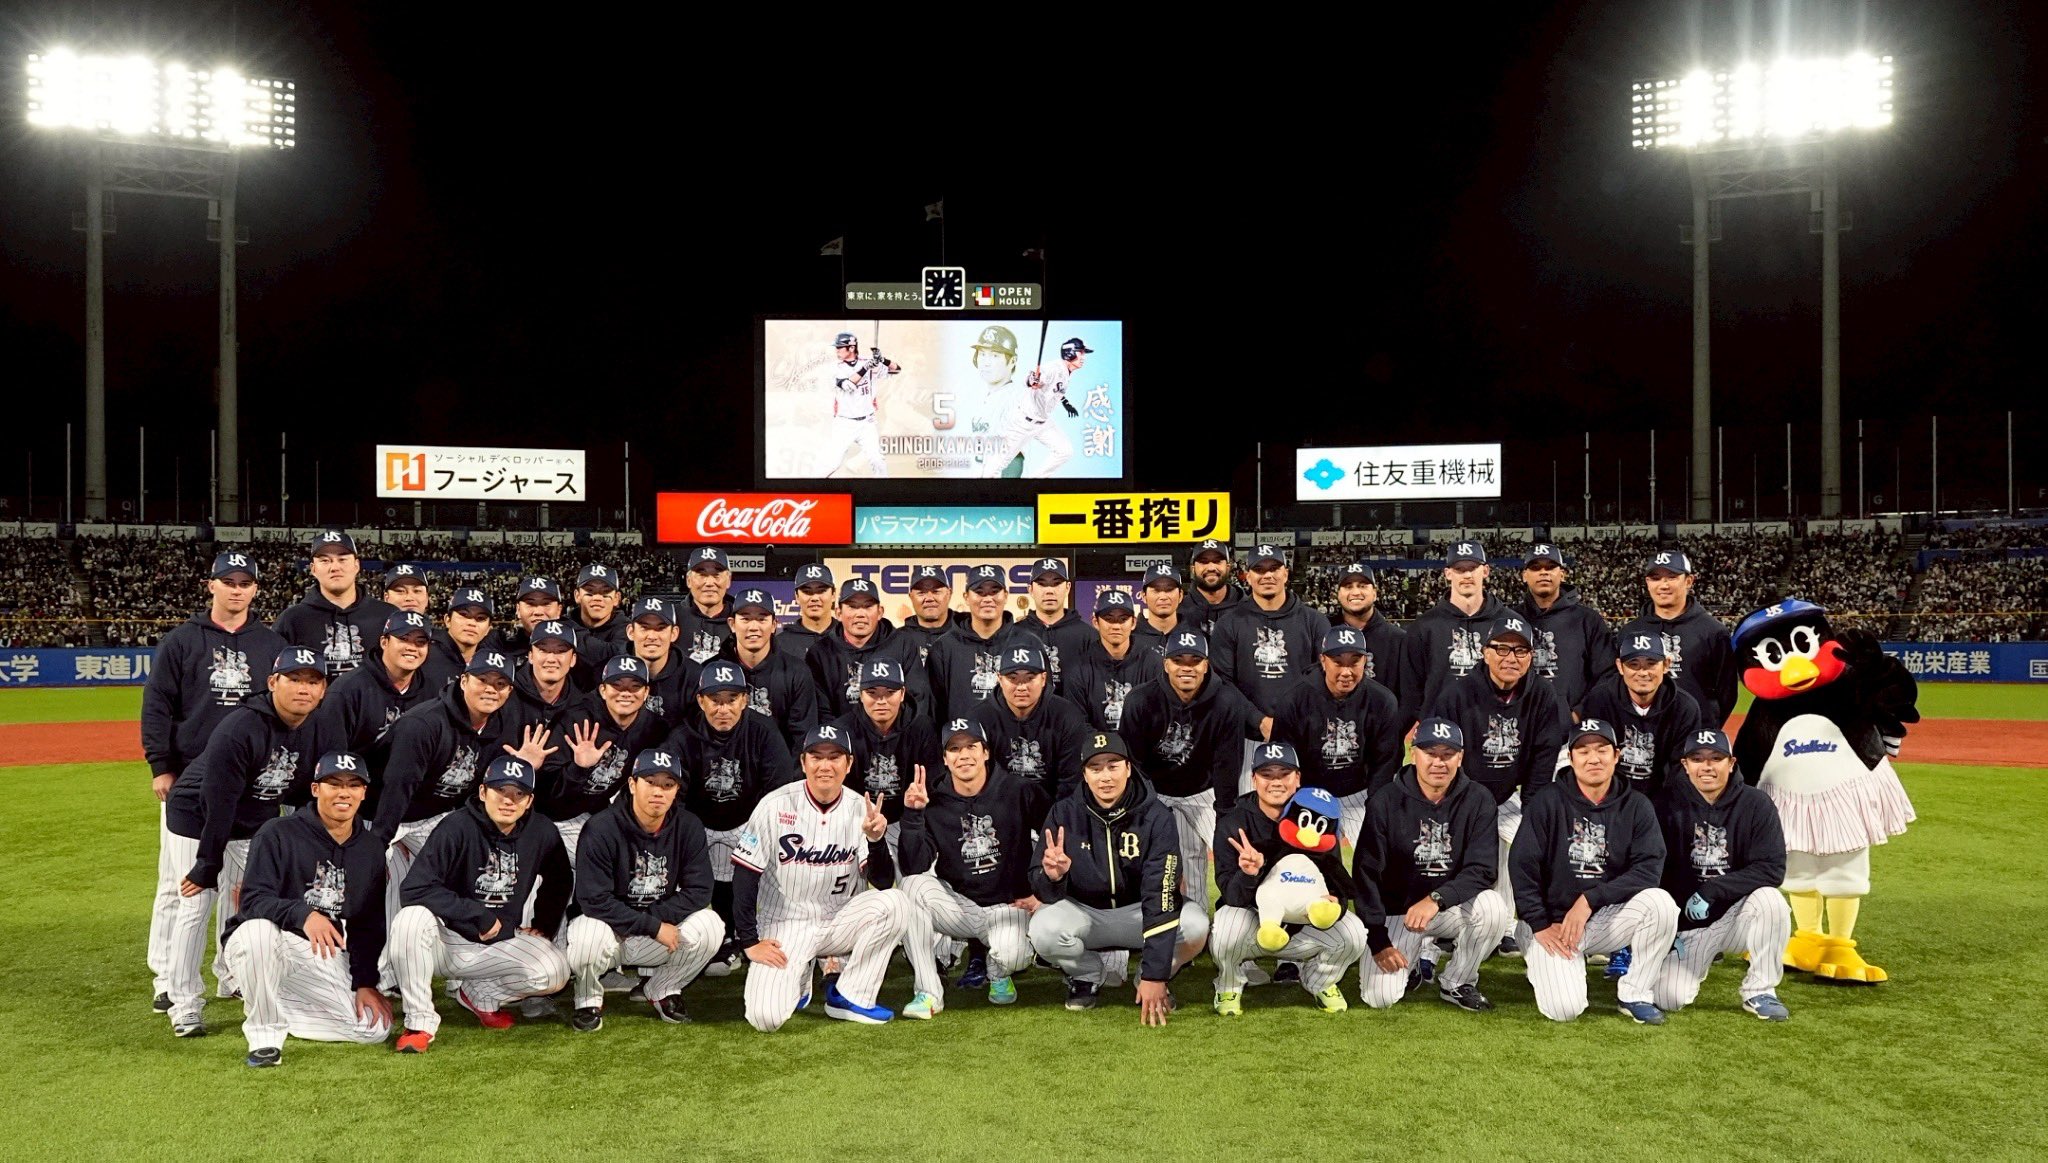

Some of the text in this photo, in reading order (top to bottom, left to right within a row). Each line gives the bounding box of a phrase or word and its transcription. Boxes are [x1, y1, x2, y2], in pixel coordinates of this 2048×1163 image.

[998, 287, 1032, 297] OPEN
[999, 297, 1032, 306] HOUSE
[931, 391, 957, 431] 5
[1081, 382, 1117, 458] 感謝
[879, 435, 933, 456] SHINGO
[433, 467, 578, 495] フージャース
[1353, 457, 1496, 488] 住友重機械
[696, 498, 819, 538] Coca-Cola
[857, 514, 1032, 537] パラマウントベッド
[1049, 497, 1218, 539] 一番搾り
[729, 559, 765, 568] EKNOS
[1094, 734, 1107, 748] B
[1118, 832, 1140, 860] B
[831, 873, 850, 895] 5
